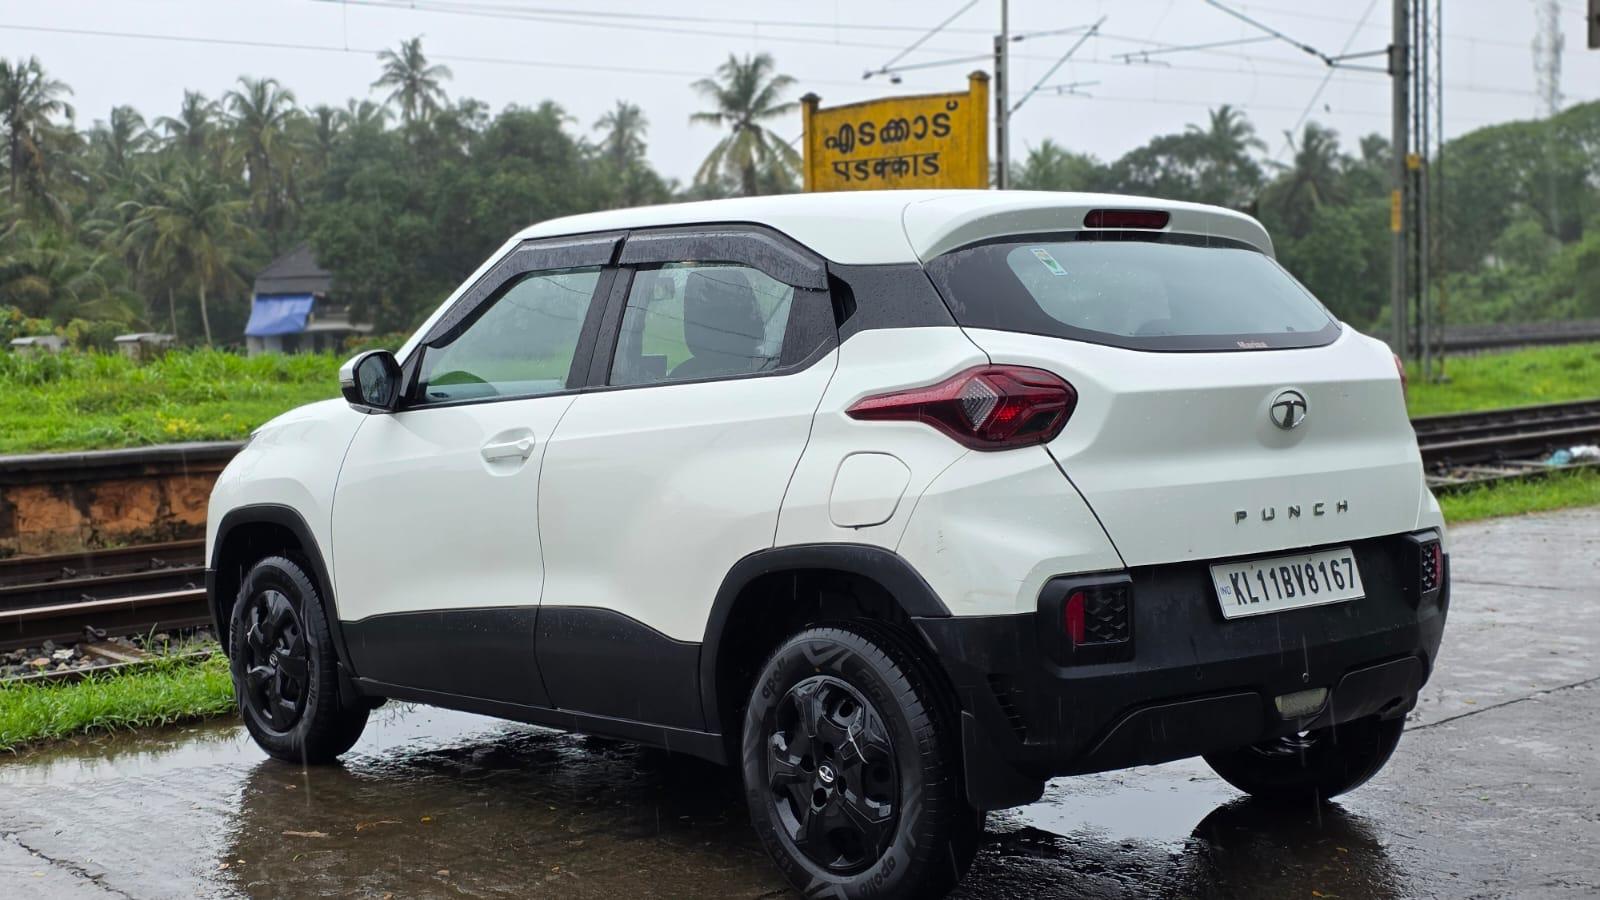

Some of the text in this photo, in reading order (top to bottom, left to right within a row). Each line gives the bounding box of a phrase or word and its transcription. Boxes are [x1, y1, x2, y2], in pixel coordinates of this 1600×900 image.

[824, 100, 959, 154] എടക്കാട്
[831, 152, 940, 181] एडक्काड
[1234, 500, 1348, 525] PUNCH
[1219, 585, 1232, 595] IND
[1229, 557, 1355, 606] KL11BV8167
[859, 855, 896, 896] apollo
